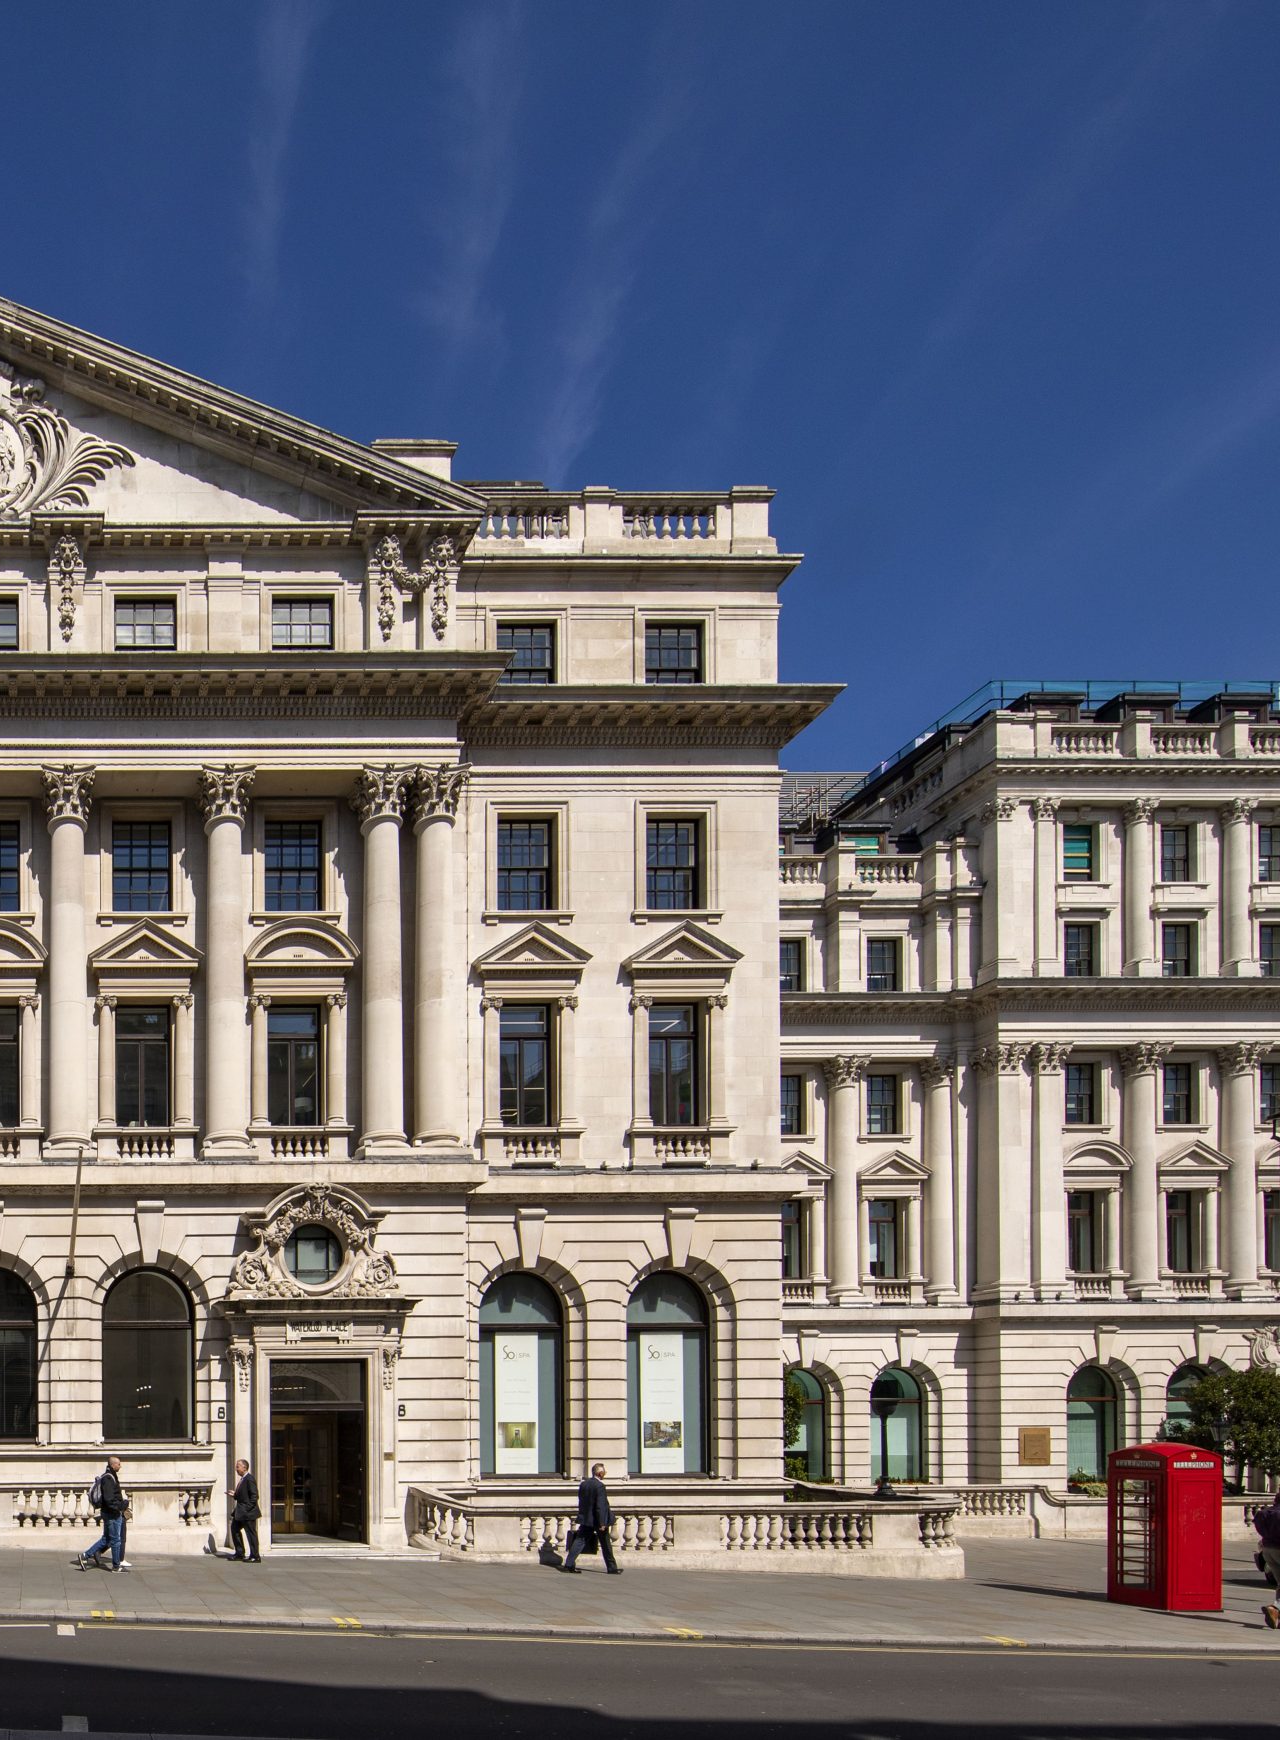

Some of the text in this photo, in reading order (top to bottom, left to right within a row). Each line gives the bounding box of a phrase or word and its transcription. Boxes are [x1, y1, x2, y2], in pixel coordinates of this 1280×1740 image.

[290, 1320, 348, 1332] WATERLOO PLACE
[217, 1406, 226, 1420] 8
[398, 1404, 406, 1417] 8
[1175, 1461, 1213, 1469] TELEPHONE
